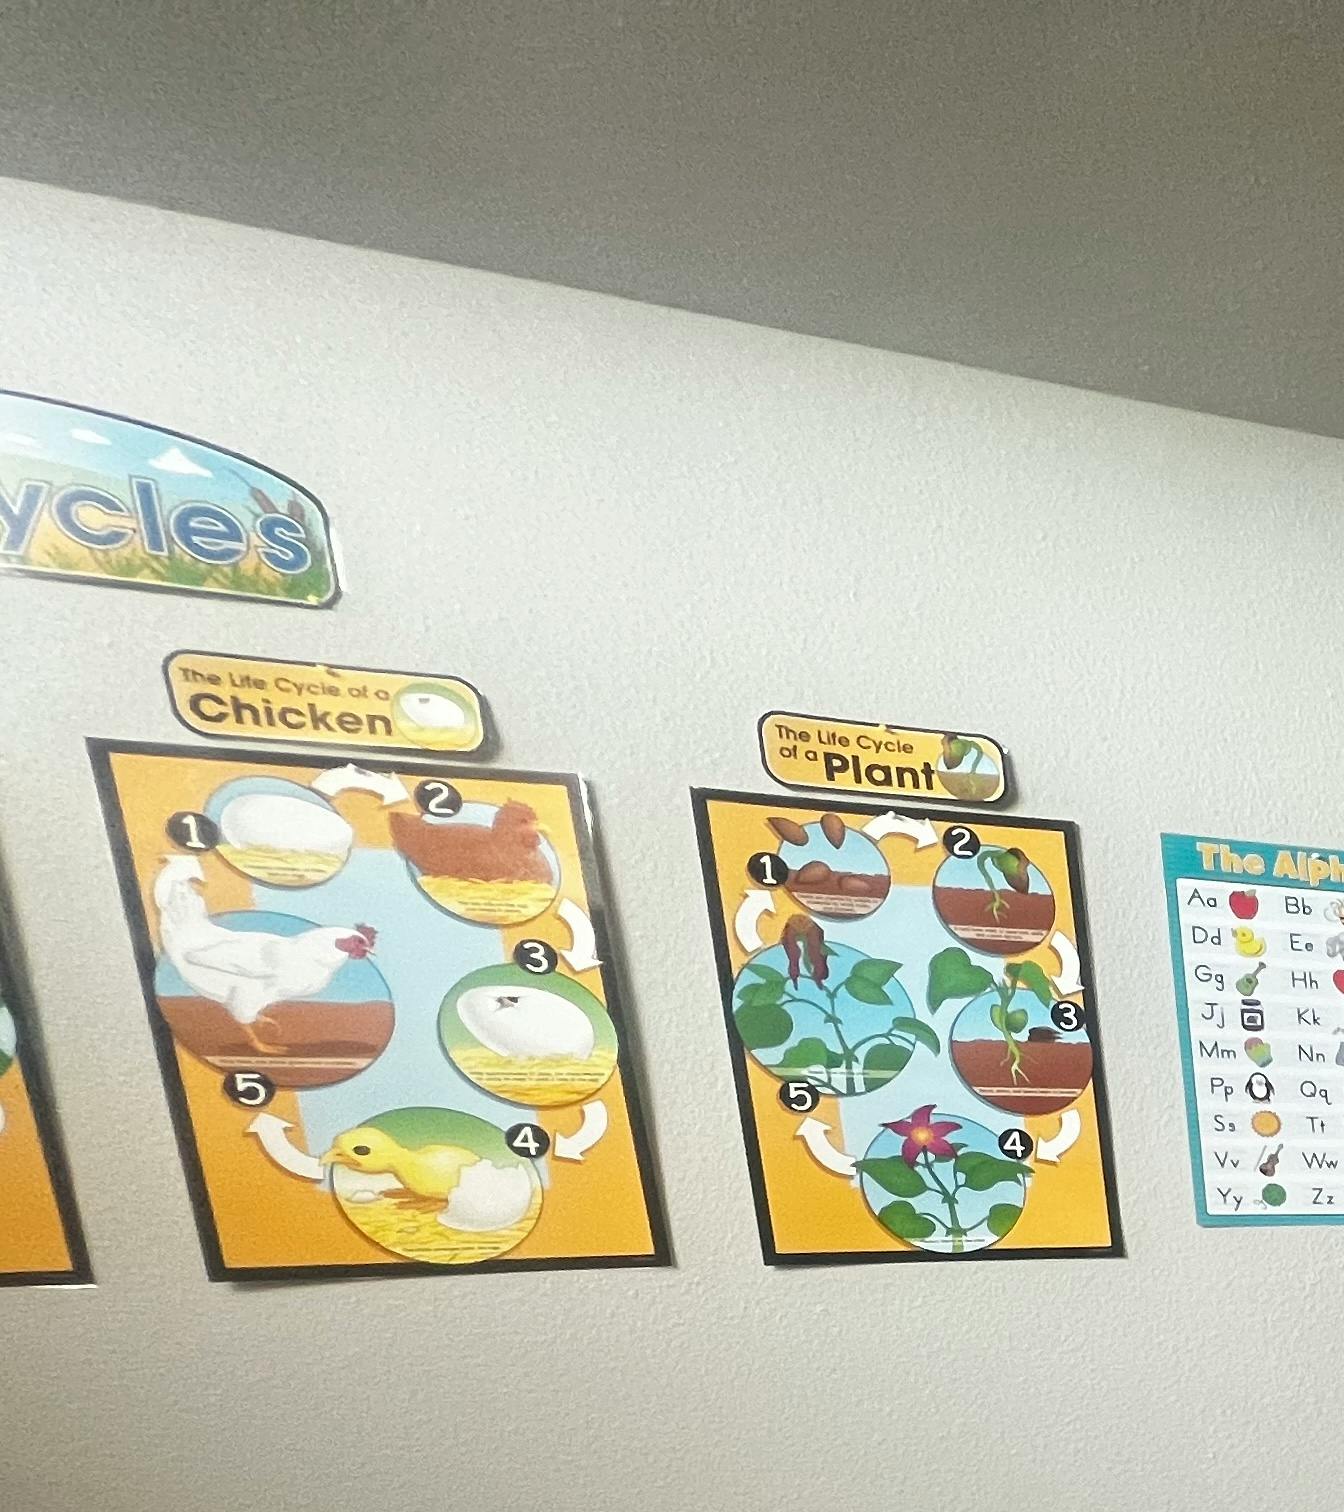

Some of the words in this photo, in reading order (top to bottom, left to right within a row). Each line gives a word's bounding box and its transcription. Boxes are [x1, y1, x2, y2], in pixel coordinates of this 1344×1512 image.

[179, 667, 221, 685] The
[229, 672, 267, 690] Life
[274, 677, 340, 697] Cycle
[348, 685, 369, 698] of
[374, 688, 390, 701] a
[189, 693, 392, 736] Chicken
[775, 724, 811, 742] The
[818, 730, 850, 747] Life
[856, 735, 913, 753] Cycle
[779, 745, 798, 759] of
[805, 750, 818, 761] a
[824, 752, 935, 790] Plant
[424, 783, 451, 815] 2
[184, 814, 206, 849] 1
[947, 828, 975, 859] 2
[757, 855, 776, 885] 1
[1196, 842, 1265, 875] The
[1187, 888, 1217, 907] Aa
[1285, 896, 1312, 915] Bb
[1192, 926, 1221, 945] Dd
[1290, 933, 1313, 952] Ee
[521, 942, 549, 974] 3
[1195, 965, 1224, 991] Gg
[1292, 971, 1318, 989] Hh
[1057, 1002, 1080, 1031] 3
[1201, 1003, 1224, 1029] Jj
[1297, 1008, 1320, 1025] Kk
[1199, 1040, 1236, 1058] Mm
[1299, 1045, 1325, 1062] Nn
[235, 1074, 265, 1105] 5
[787, 1082, 814, 1112] 5
[1211, 1077, 1233, 1102] Pp
[1300, 1081, 1332, 1105] Qq
[1214, 1115, 1235, 1132] Ss
[1306, 1116, 1325, 1133] Tt
[510, 1124, 545, 1156] 4
[1003, 1130, 1028, 1157] 4
[1214, 1152, 1239, 1168] Vv
[1302, 1152, 1338, 1169] Ww
[1217, 1188, 1243, 1211] Yy
[1312, 1188, 1334, 1204] Zz
